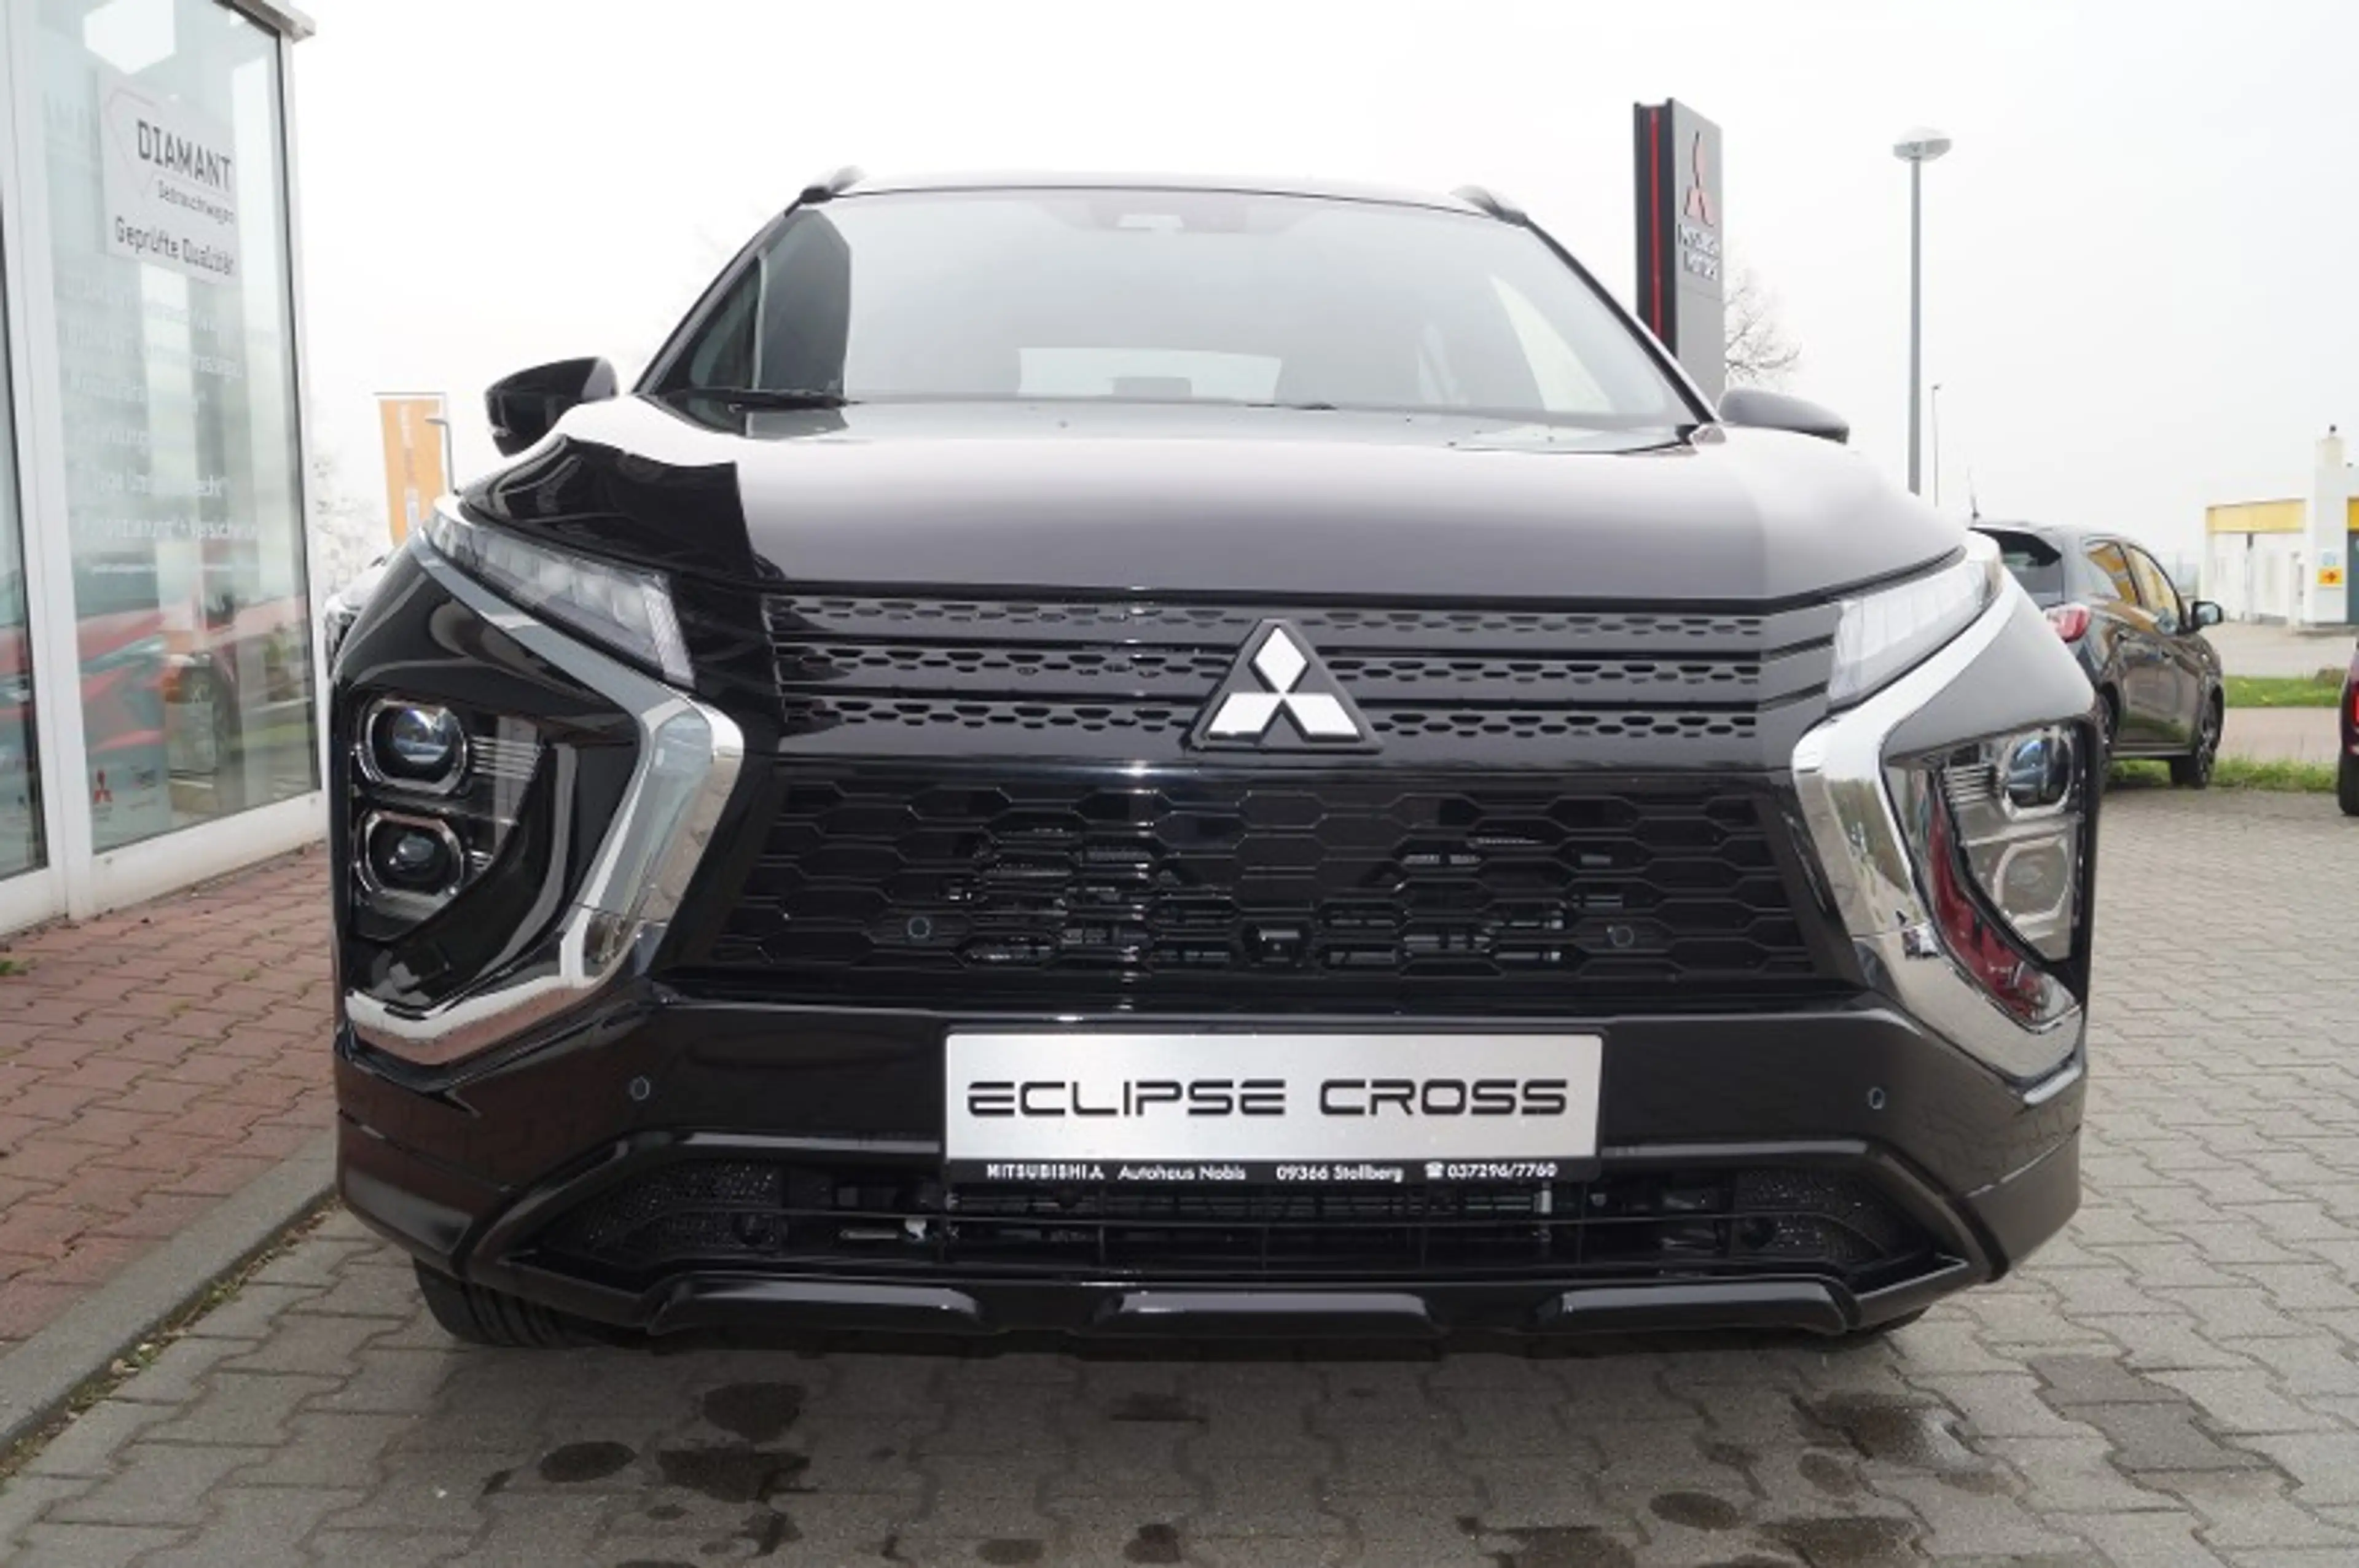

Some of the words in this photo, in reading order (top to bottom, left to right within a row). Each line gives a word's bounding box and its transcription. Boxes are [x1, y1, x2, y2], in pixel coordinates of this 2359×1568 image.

[137, 118, 231, 192] DIAMANT
[968, 1079, 1285, 1117] ECLIPSE
[1320, 1078, 1567, 1116] CROSS
[987, 1164, 1087, 1180] MITSUBISHI
[1117, 1164, 1194, 1181] Autohaus
[1199, 1164, 1246, 1181] Nobis
[1276, 1164, 1328, 1181] 09366
[1333, 1164, 1404, 1184] Stollberg
